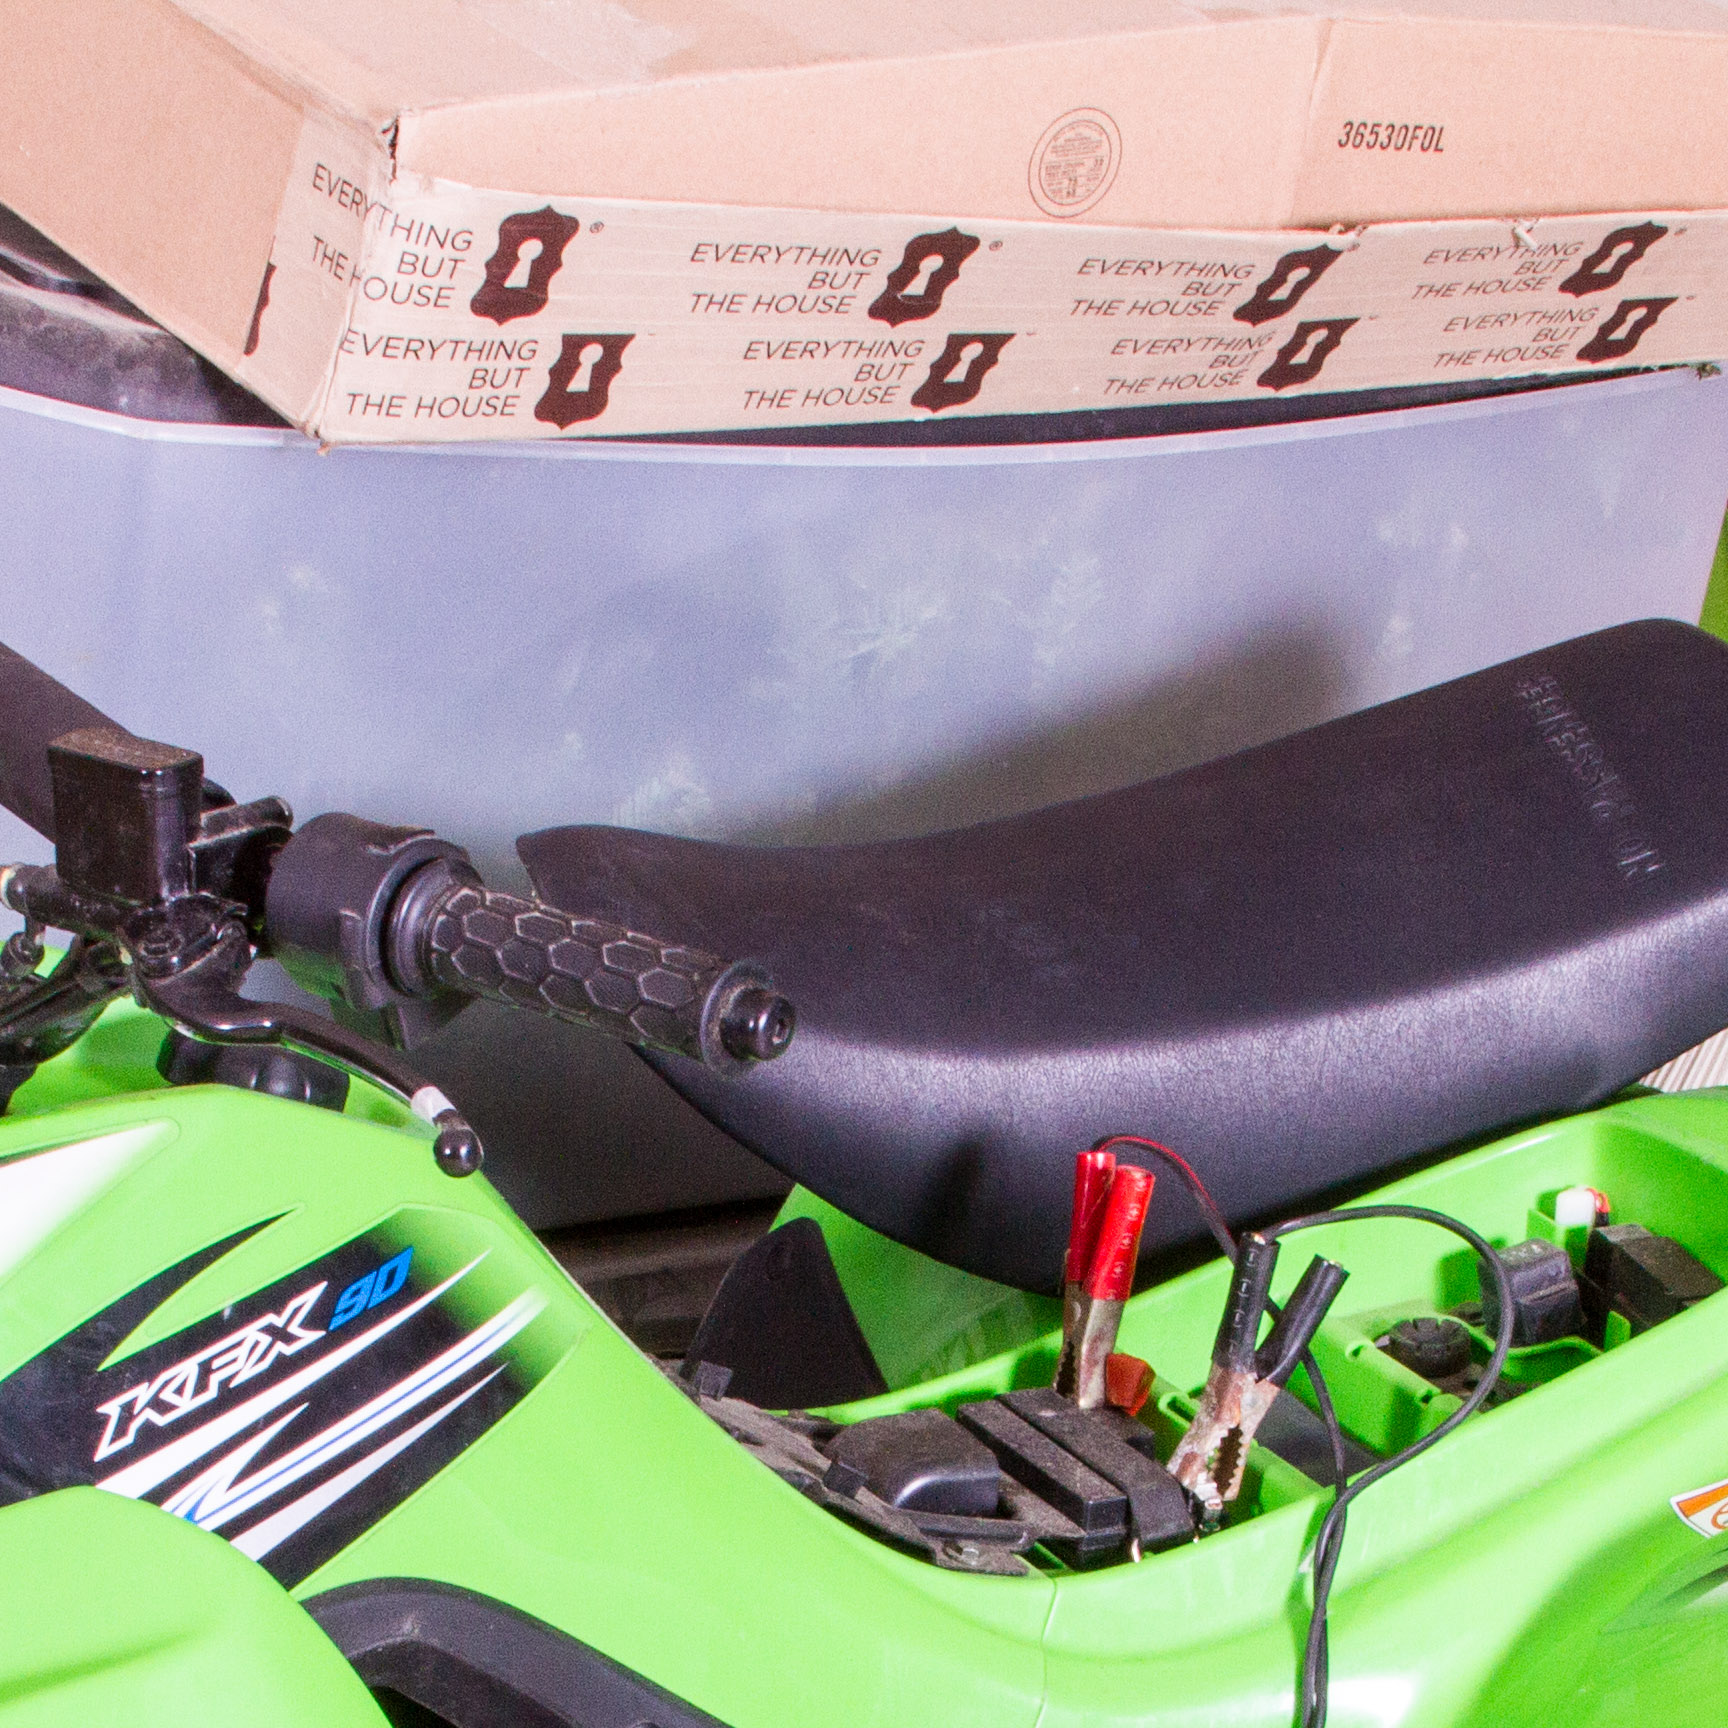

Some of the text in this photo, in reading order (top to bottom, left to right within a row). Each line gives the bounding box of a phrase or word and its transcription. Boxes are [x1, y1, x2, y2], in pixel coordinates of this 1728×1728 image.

[313, 163, 473, 252] EVERYTHING
[312, 235, 349, 281] THE
[690, 243, 882, 268] EVERYTHING
[1423, 241, 1584, 265] EVERYTHING
[397, 251, 466, 280] BUT
[1077, 258, 1256, 280] EVERYTHING
[1513, 258, 1569, 276] BUT
[807, 271, 871, 290] BUT
[1181, 281, 1243, 298] BUT
[1411, 276, 1553, 299] THE HOUSE
[690, 293, 857, 314] THE HOUSE
[1070, 299, 1225, 317] THE HOUSE
[1443, 307, 1600, 332] EVERYTHING
[339, 328, 539, 362] EVERYTHING
[1110, 331, 1277, 355] EVERYTHING
[1532, 326, 1583, 343] BUT
[743, 339, 925, 360] EVERYTHING
[1208, 350, 1259, 369] BUT
[1433, 344, 1571, 368] THE HOUSE
[468, 367, 531, 391] BUT
[854, 362, 915, 382] BUT
[1102, 368, 1249, 395] THE HOUSE
[346, 392, 521, 419] THE HOUSE
[743, 385, 901, 410] THE HOUSE
[93, 1245, 414, 1462] KFX 90
